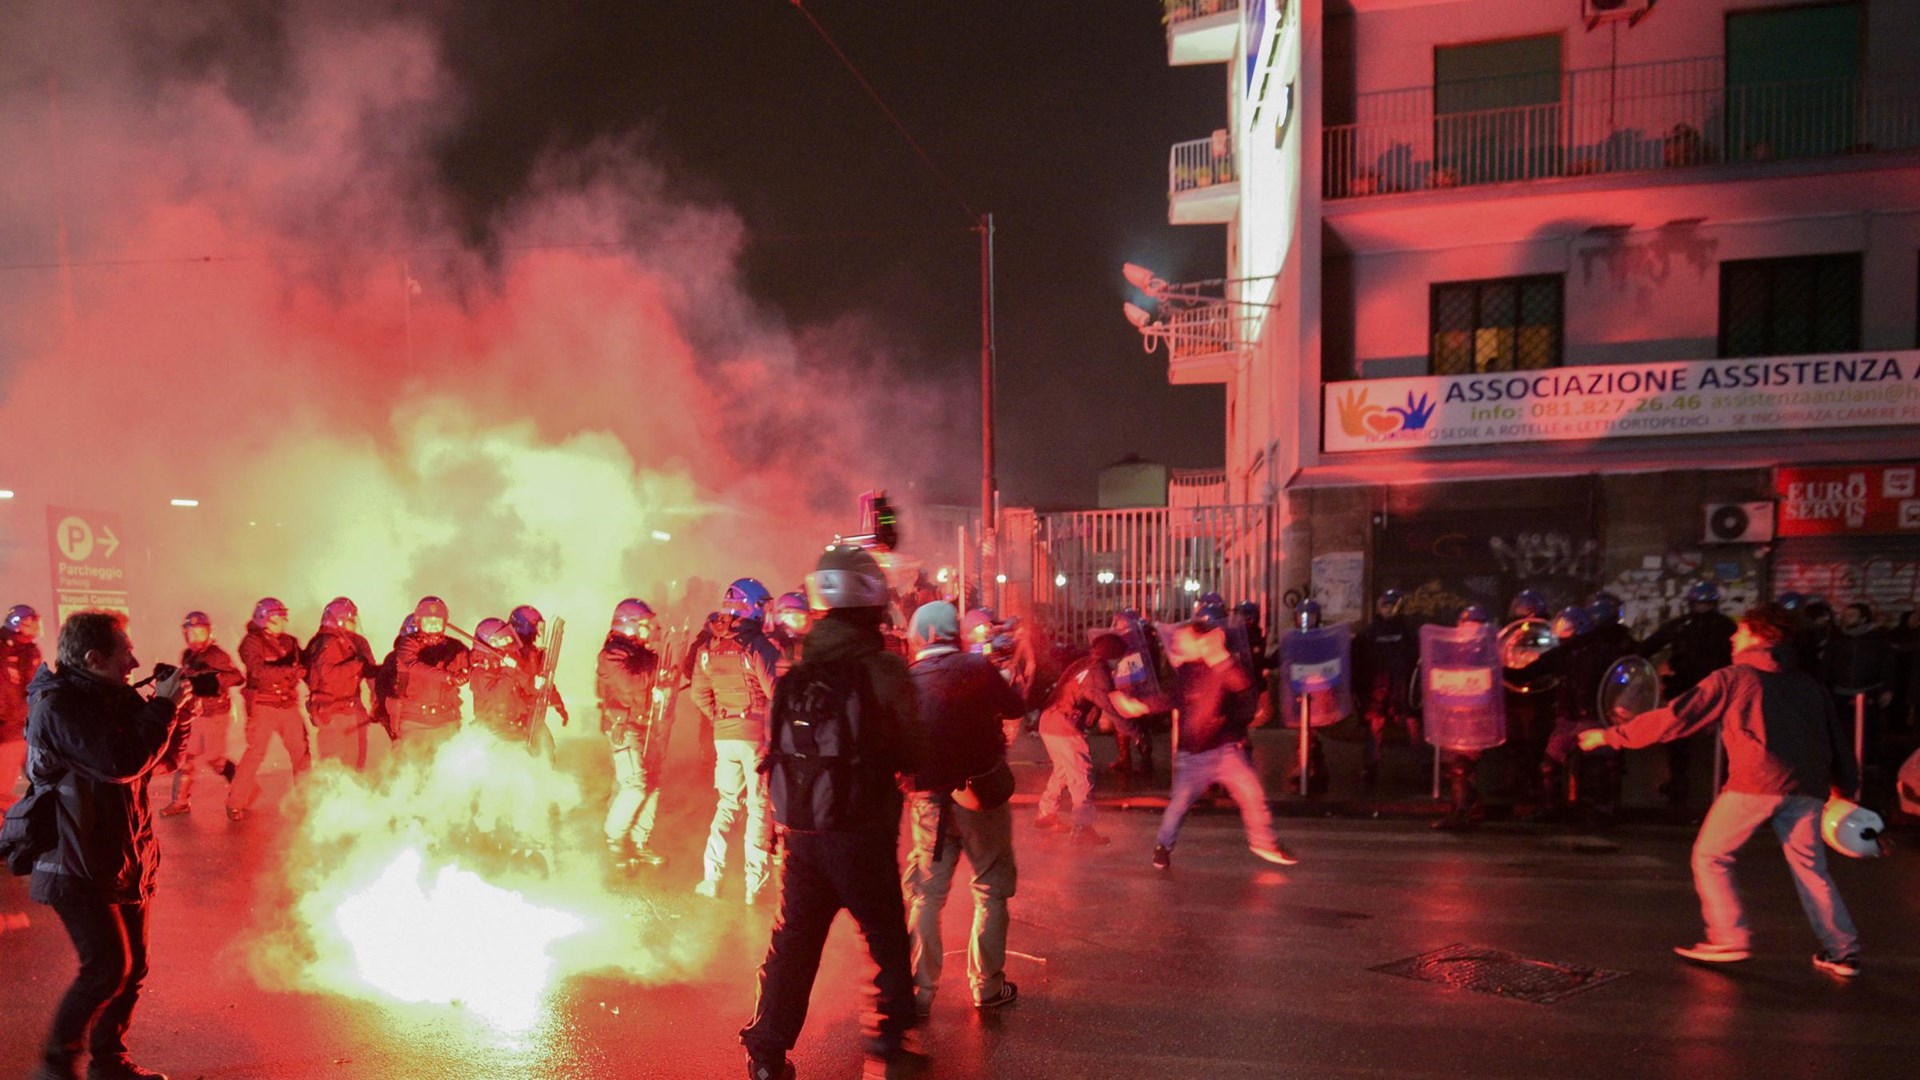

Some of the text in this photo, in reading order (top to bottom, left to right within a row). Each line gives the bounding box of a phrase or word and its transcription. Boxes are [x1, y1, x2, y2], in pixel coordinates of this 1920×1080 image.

[1445, 367, 1687, 403] ASSOCIAZIONE
[1698, 358, 1903, 389] ASSISTENZA
[1471, 402, 1522, 421] info:
[1788, 481, 1867, 501] EURO
[1786, 500, 1866, 519] SERVIS
[67, 524, 85, 554] P
[59, 562, 123, 580] Parcheggio
